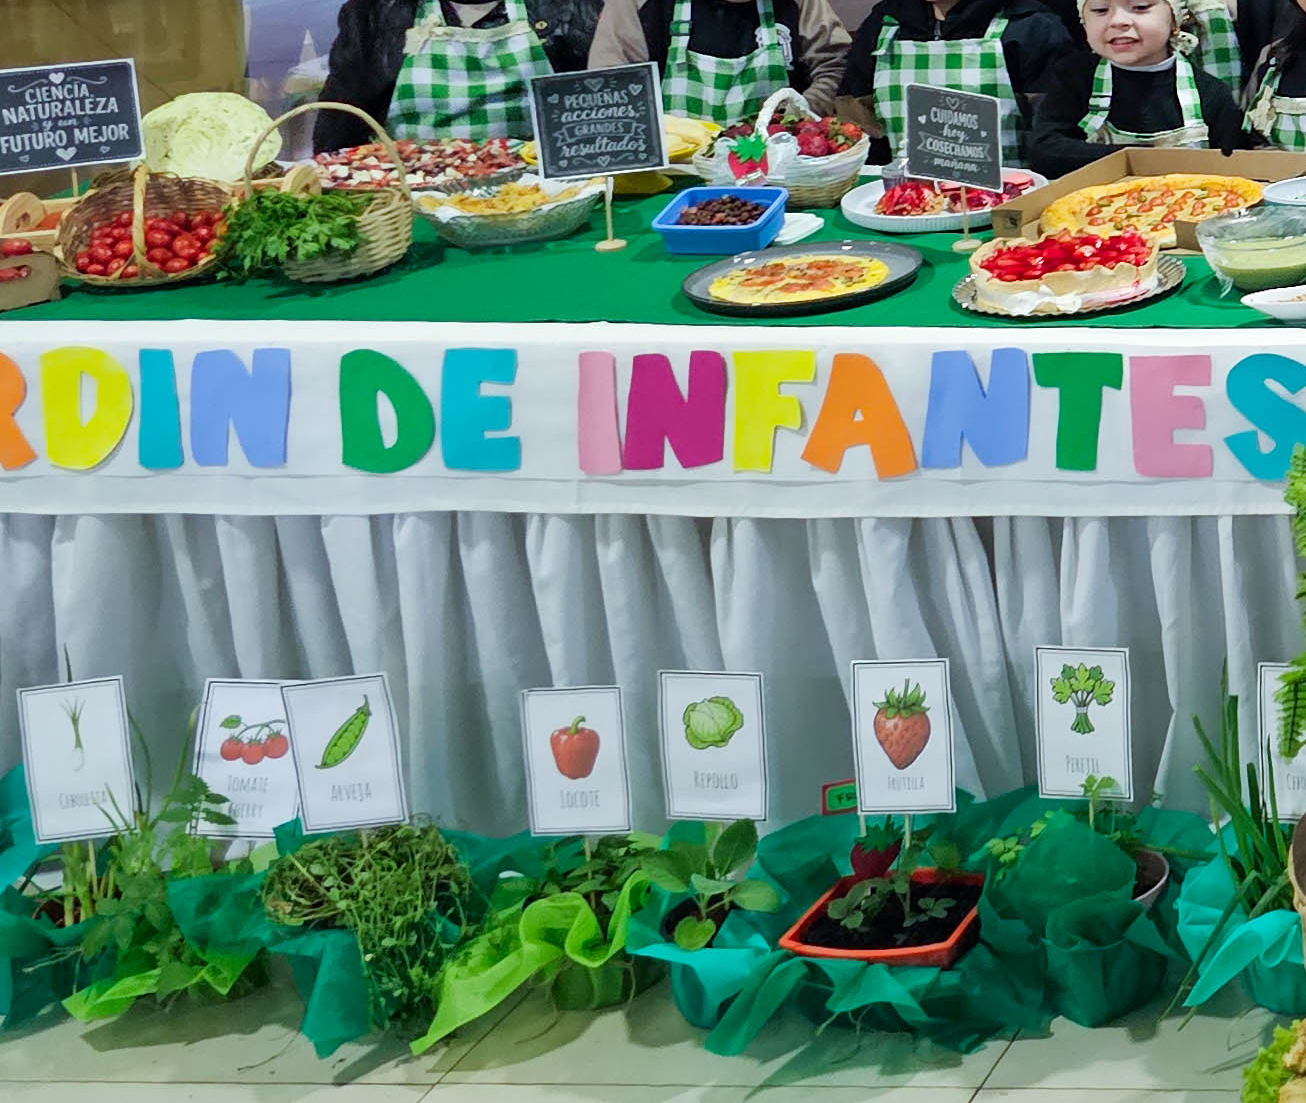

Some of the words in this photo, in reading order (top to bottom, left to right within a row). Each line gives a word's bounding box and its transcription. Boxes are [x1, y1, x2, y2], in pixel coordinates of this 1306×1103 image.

[563, 88, 629, 109] PEQUEÑAS
[1, 96, 119, 125] NATURALEZA
[561, 104, 640, 123] acciones,
[930, 106, 979, 130] CUIDAMOS
[42, 119, 54, 132] y
[57, 116, 79, 128] un
[574, 121, 625, 137] GRANDES
[0, 129, 68, 155] FUTURO
[73, 123, 130, 145] MEJOR
[560, 136, 648, 158] resultados
[926, 136, 985, 159] COSECHAMOS
[933, 157, 979, 172] mañana
[339, 347, 522, 474] DE
[226, 775, 270, 793] TOMATE
[693, 770, 739, 791] REPOLLO
[560, 789, 600, 809] LOCOTE
